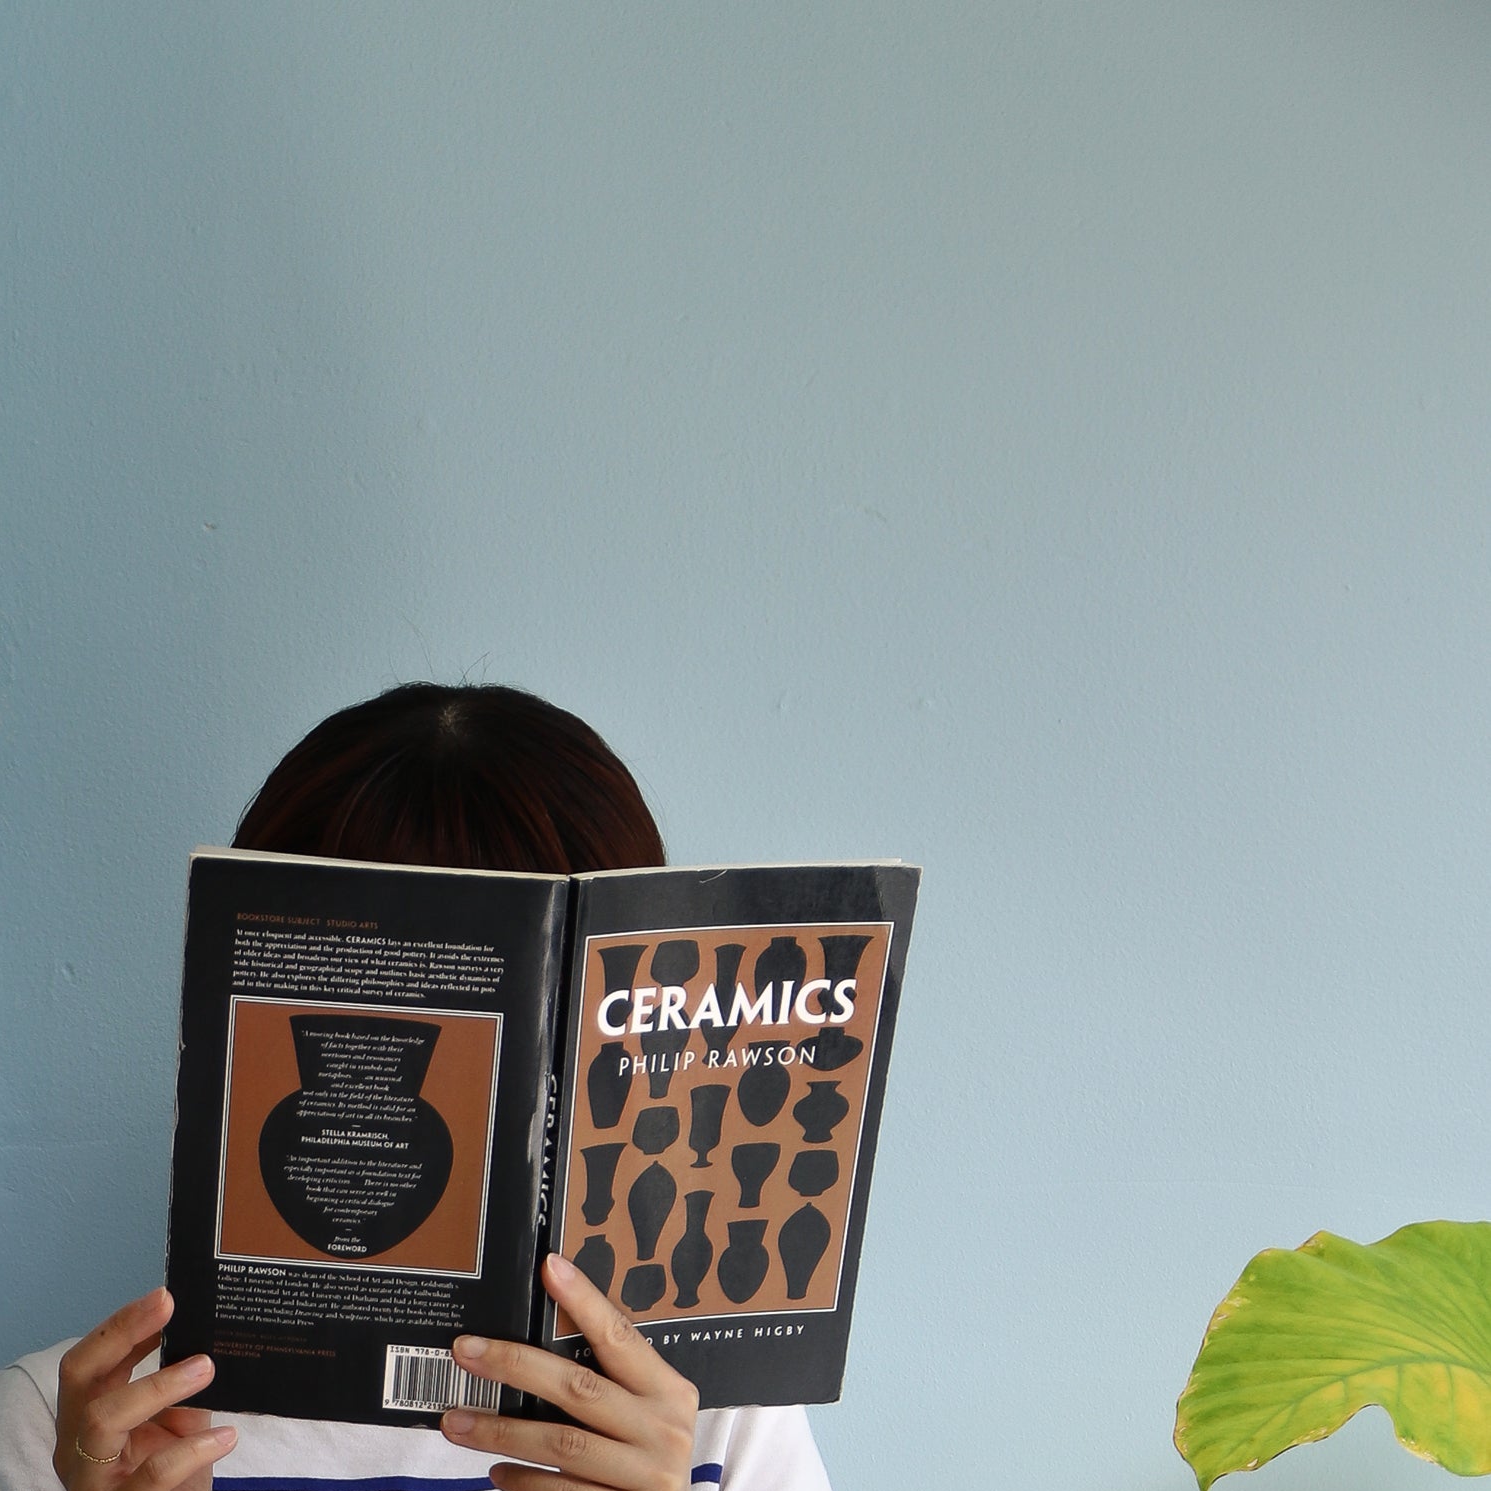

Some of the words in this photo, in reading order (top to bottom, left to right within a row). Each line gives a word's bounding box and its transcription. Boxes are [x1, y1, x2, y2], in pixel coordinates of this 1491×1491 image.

[346, 936, 386, 945] CERAMICS
[597, 978, 858, 1037] CERAMICS
[618, 1050, 697, 1077] PHILIP
[708, 1045, 817, 1069] RAWSON
[321, 1129, 345, 1137] STELLA
[301, 1136, 350, 1146] PHILADELPHIA
[351, 1139, 383, 1148] MUSEUM
[394, 1142, 410, 1150] ART
[328, 1244, 367, 1253] FOREWORD
[218, 1264, 246, 1273] PHILIP
[248, 1266, 286, 1277] RAWSON
[662, 1333, 682, 1345] BY
[690, 1328, 744, 1342] WAYNE
[754, 1324, 805, 1338] HIGBY
[390, 1346, 410, 1354] ISBN
[384, 1398, 390, 1406] 9
[427, 1401, 455, 1411] 2115
